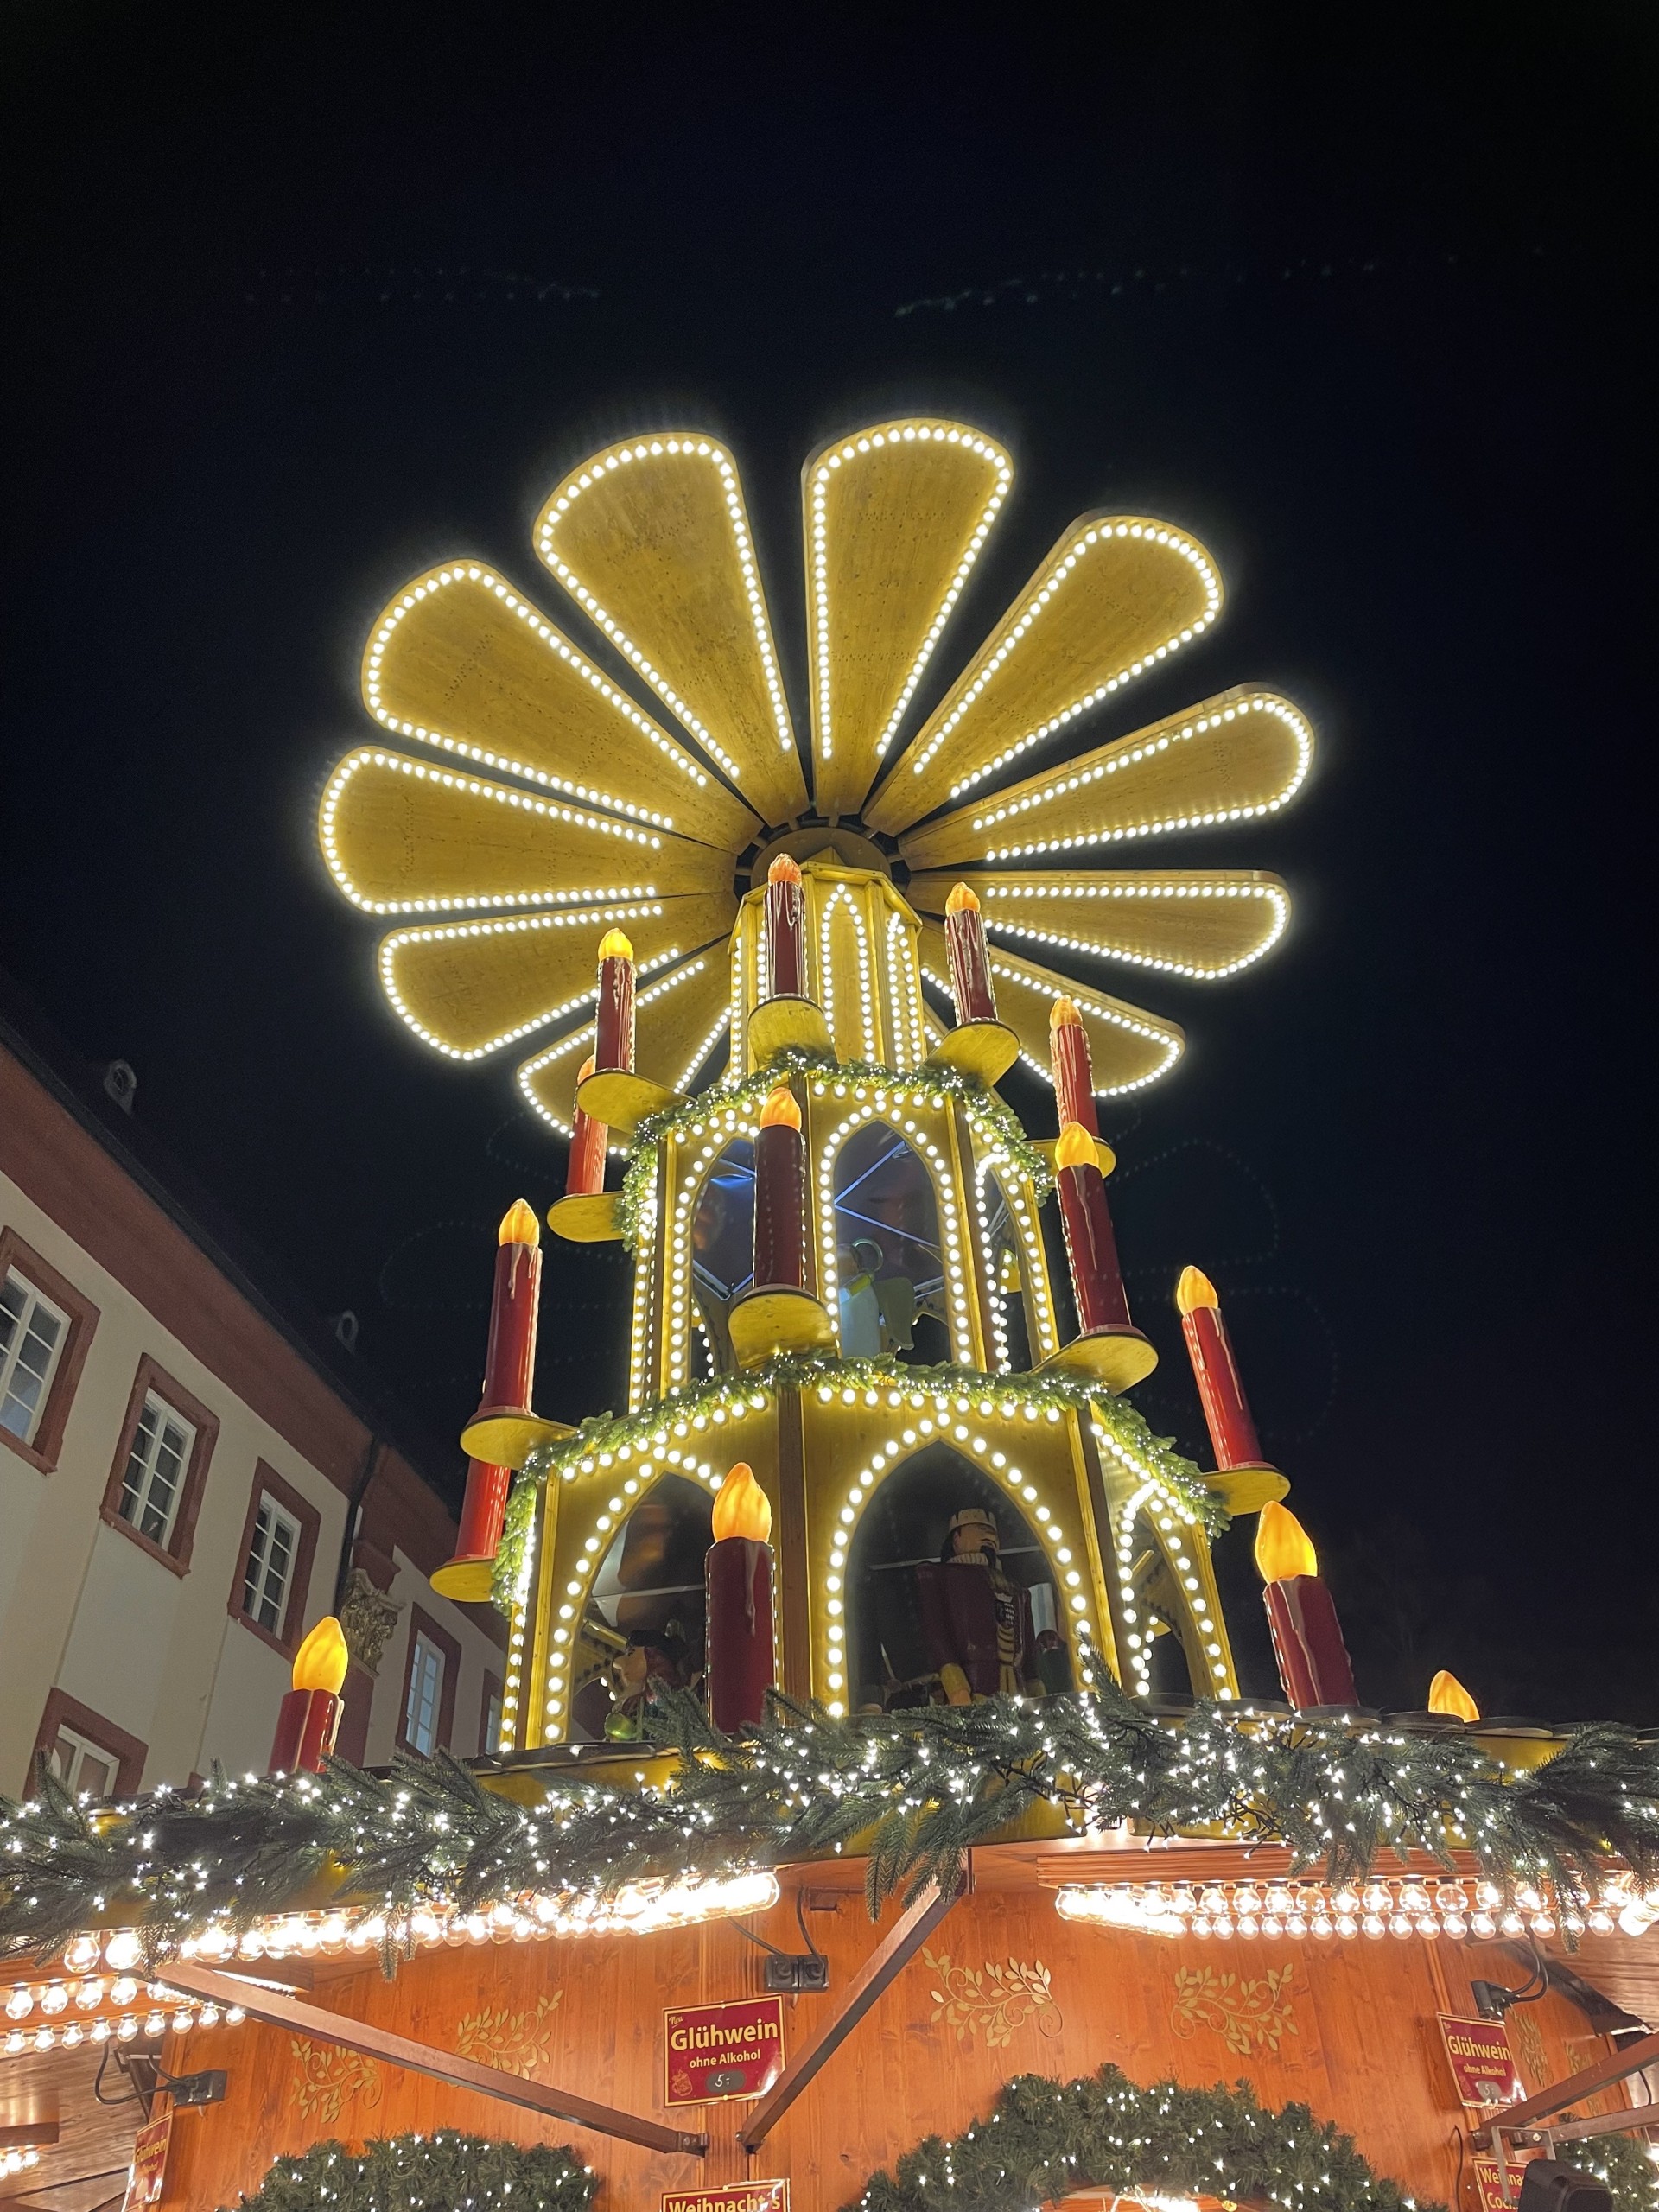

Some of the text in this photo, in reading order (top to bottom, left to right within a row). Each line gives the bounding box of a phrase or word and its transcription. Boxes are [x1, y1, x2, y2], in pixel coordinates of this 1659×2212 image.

[671, 2018, 778, 2051] Glühwein
[689, 2048, 761, 2069] ohne Alkohol
[1447, 2035, 1512, 2061] Glühwein
